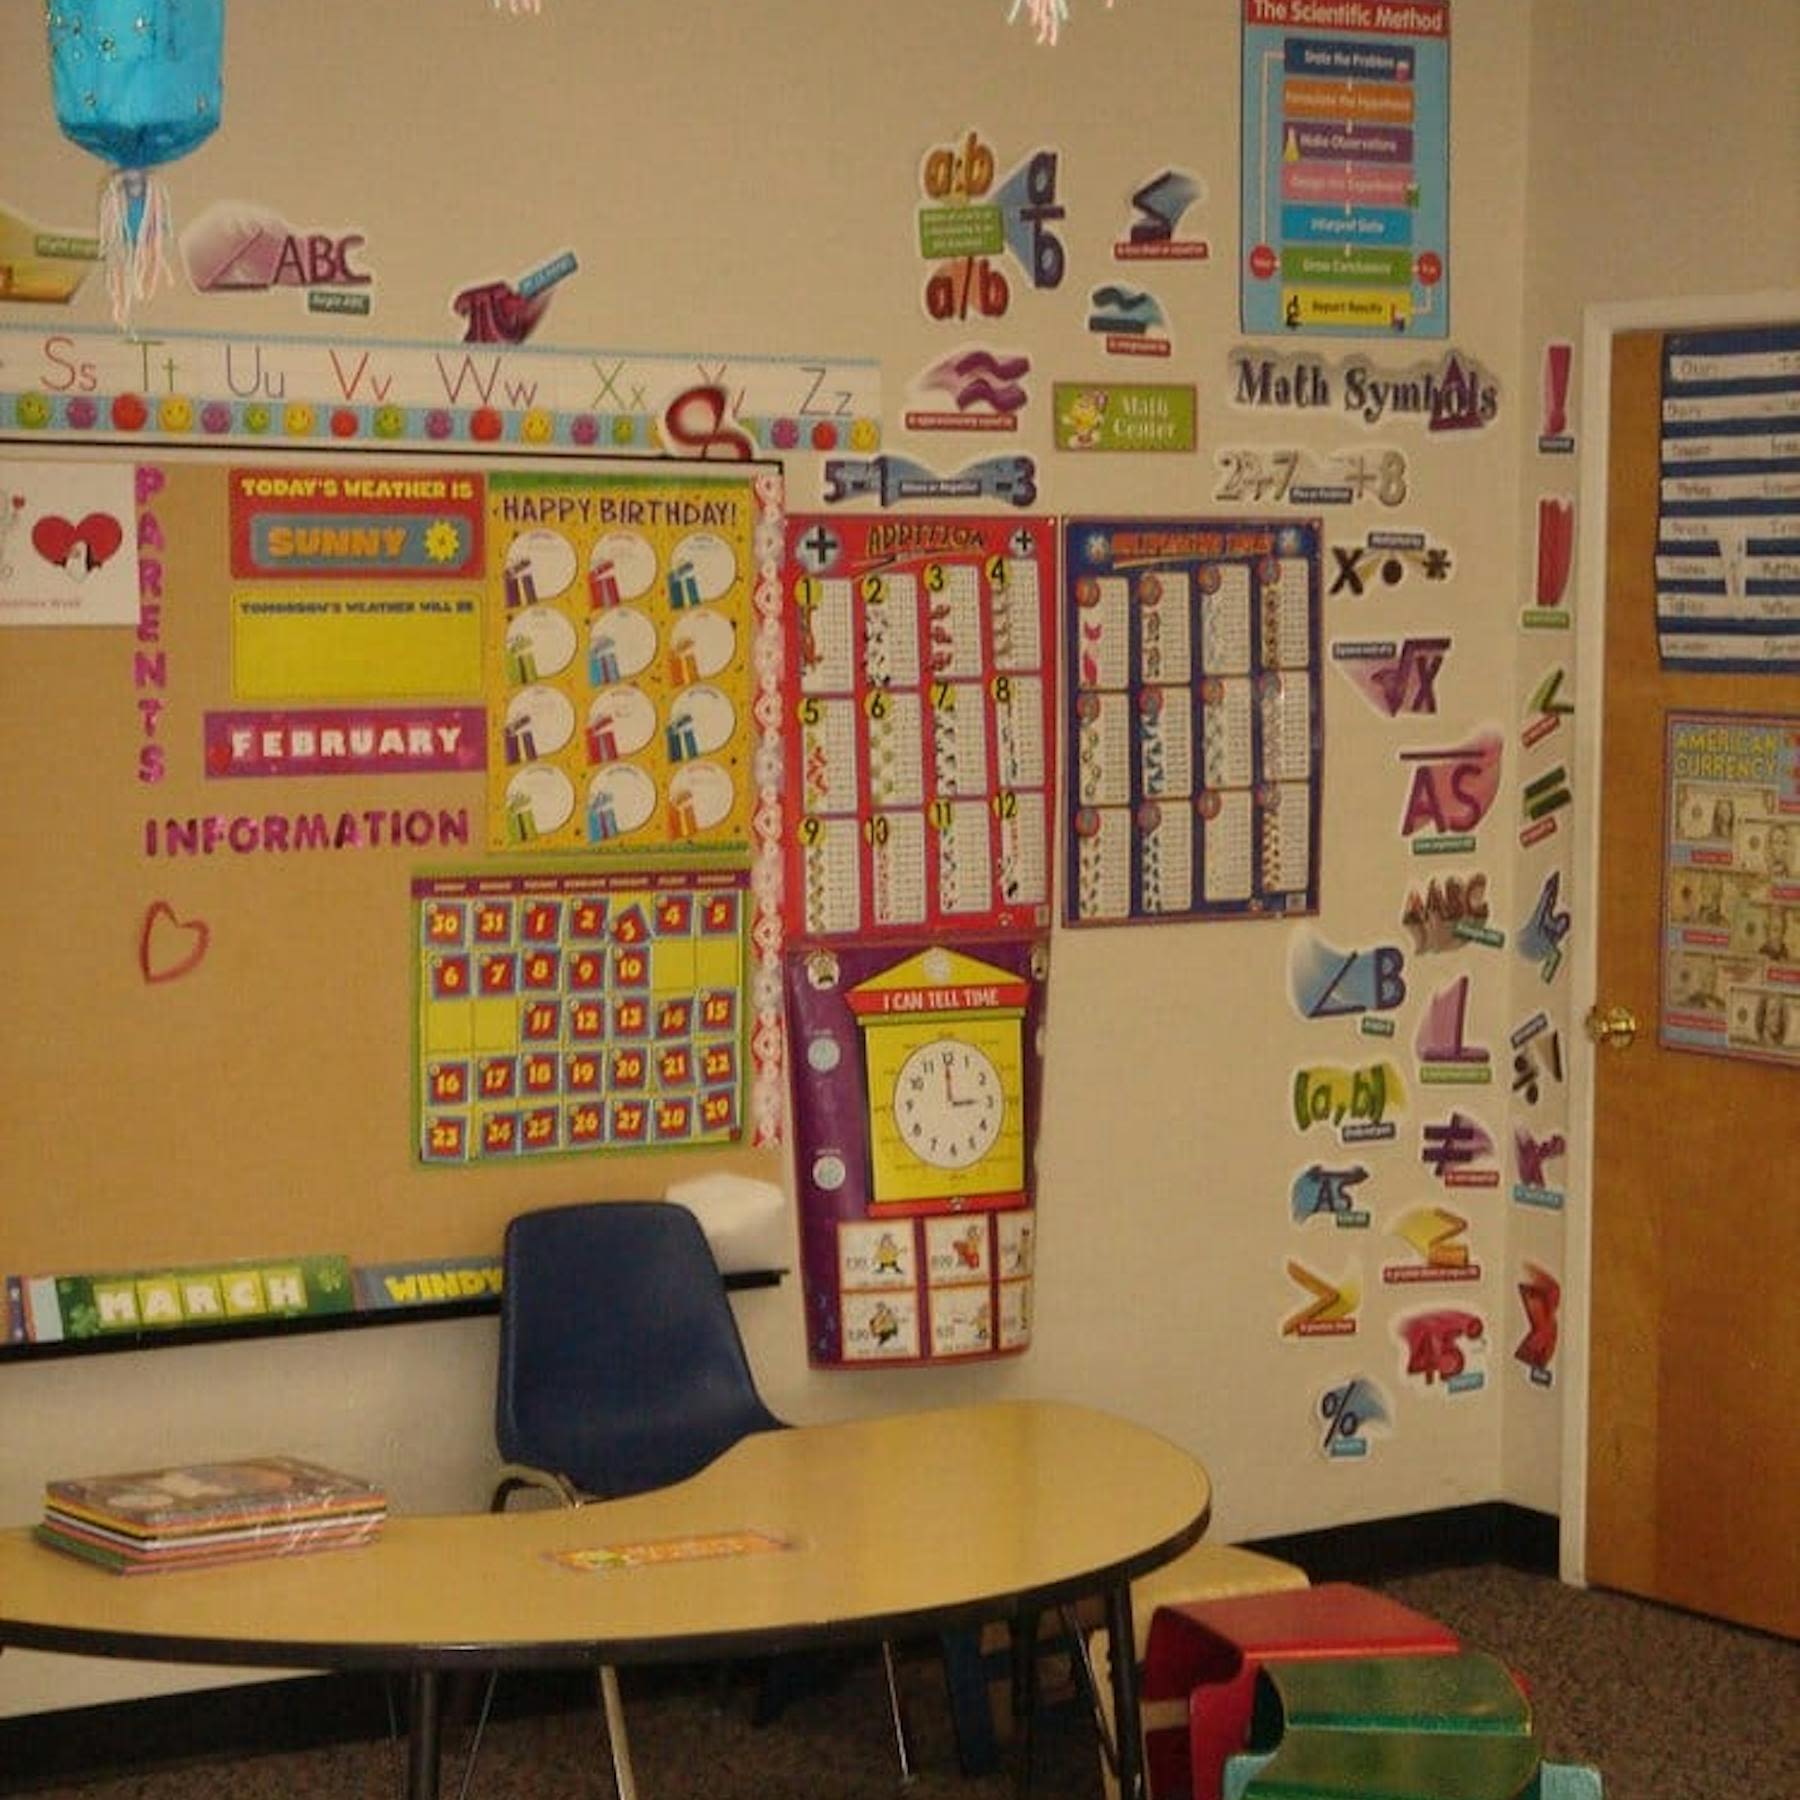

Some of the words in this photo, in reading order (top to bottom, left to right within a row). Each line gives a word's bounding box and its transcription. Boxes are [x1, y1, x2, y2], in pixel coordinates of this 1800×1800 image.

[1256, 1, 1288, 20] The
[1294, 4, 1371, 27] Scientific
[1375, 10, 1442, 33] Method
[273, 235, 372, 284] ABC
[40, 336, 99, 392] Ss
[123, 341, 180, 393] Tt
[225, 344, 286, 400] Uu
[330, 349, 393, 401] Vv
[435, 353, 538, 408] Ww
[592, 360, 646, 409] Xx
[800, 366, 853, 416] Zz
[1235, 359, 1331, 408] Math
[1122, 395, 1169, 416] Math
[1113, 414, 1177, 439] Center
[241, 477, 338, 498] TODAY'S
[343, 479, 446, 499] WEATHER
[451, 480, 474, 499] IS
[503, 496, 591, 523] HAPPY
[600, 498, 738, 528] BIRTHDAY!
[267, 526, 408, 558] SUNNY
[868, 525, 985, 553] ADDITION
[930, 564, 944, 592] 3
[990, 558, 1006, 587] 4
[802, 580, 812, 606] 1
[866, 576, 883, 605] 2
[345, 602, 415, 614] WEATHER
[134, 465, 167, 784] PARENTS
[934, 680, 950, 708] 7
[994, 675, 1011, 703] 8
[803, 698, 820, 726] 5
[870, 692, 886, 719] 6
[230, 725, 462, 759] FEBRUARY
[936, 801, 952, 829] 11
[998, 791, 1017, 820] 12
[145, 808, 469, 858] INFORMATION
[803, 816, 820, 844] 9
[431, 913, 457, 933] 30
[481, 911, 504, 932] 31
[535, 912, 546, 933] 1
[581, 910, 595, 930] 2
[621, 920, 636, 941] 3
[665, 905, 680, 925] 4
[712, 904, 726, 923] 5
[444, 966, 458, 987] 6
[490, 963, 506, 986] 7
[532, 960, 548, 980] 8
[579, 960, 593, 980] 9
[619, 957, 641, 978] 10
[531, 1008, 551, 1031] 11
[578, 1008, 598, 1031] 12
[620, 1005, 641, 1027] 13
[706, 999, 729, 1021] 15
[882, 994, 890, 1012] I
[892, 993, 923, 1011] CAN
[927, 990, 962, 1009] TELL
[964, 987, 1000, 1007] TIME
[436, 1073, 460, 1095] 16
[485, 1068, 509, 1089] 17
[528, 1063, 551, 1084] 18
[571, 1062, 595, 1084] 19
[617, 1057, 641, 1079] 20
[663, 1055, 685, 1076] 21
[705, 1053, 730, 1076] 22
[431, 1126, 458, 1148] 23
[527, 1117, 551, 1139] 25
[572, 1111, 598, 1133] 26
[617, 1108, 640, 1131] 27
[96, 1275, 305, 1325] MARCH
[384, 1266, 504, 1303] WINDY
